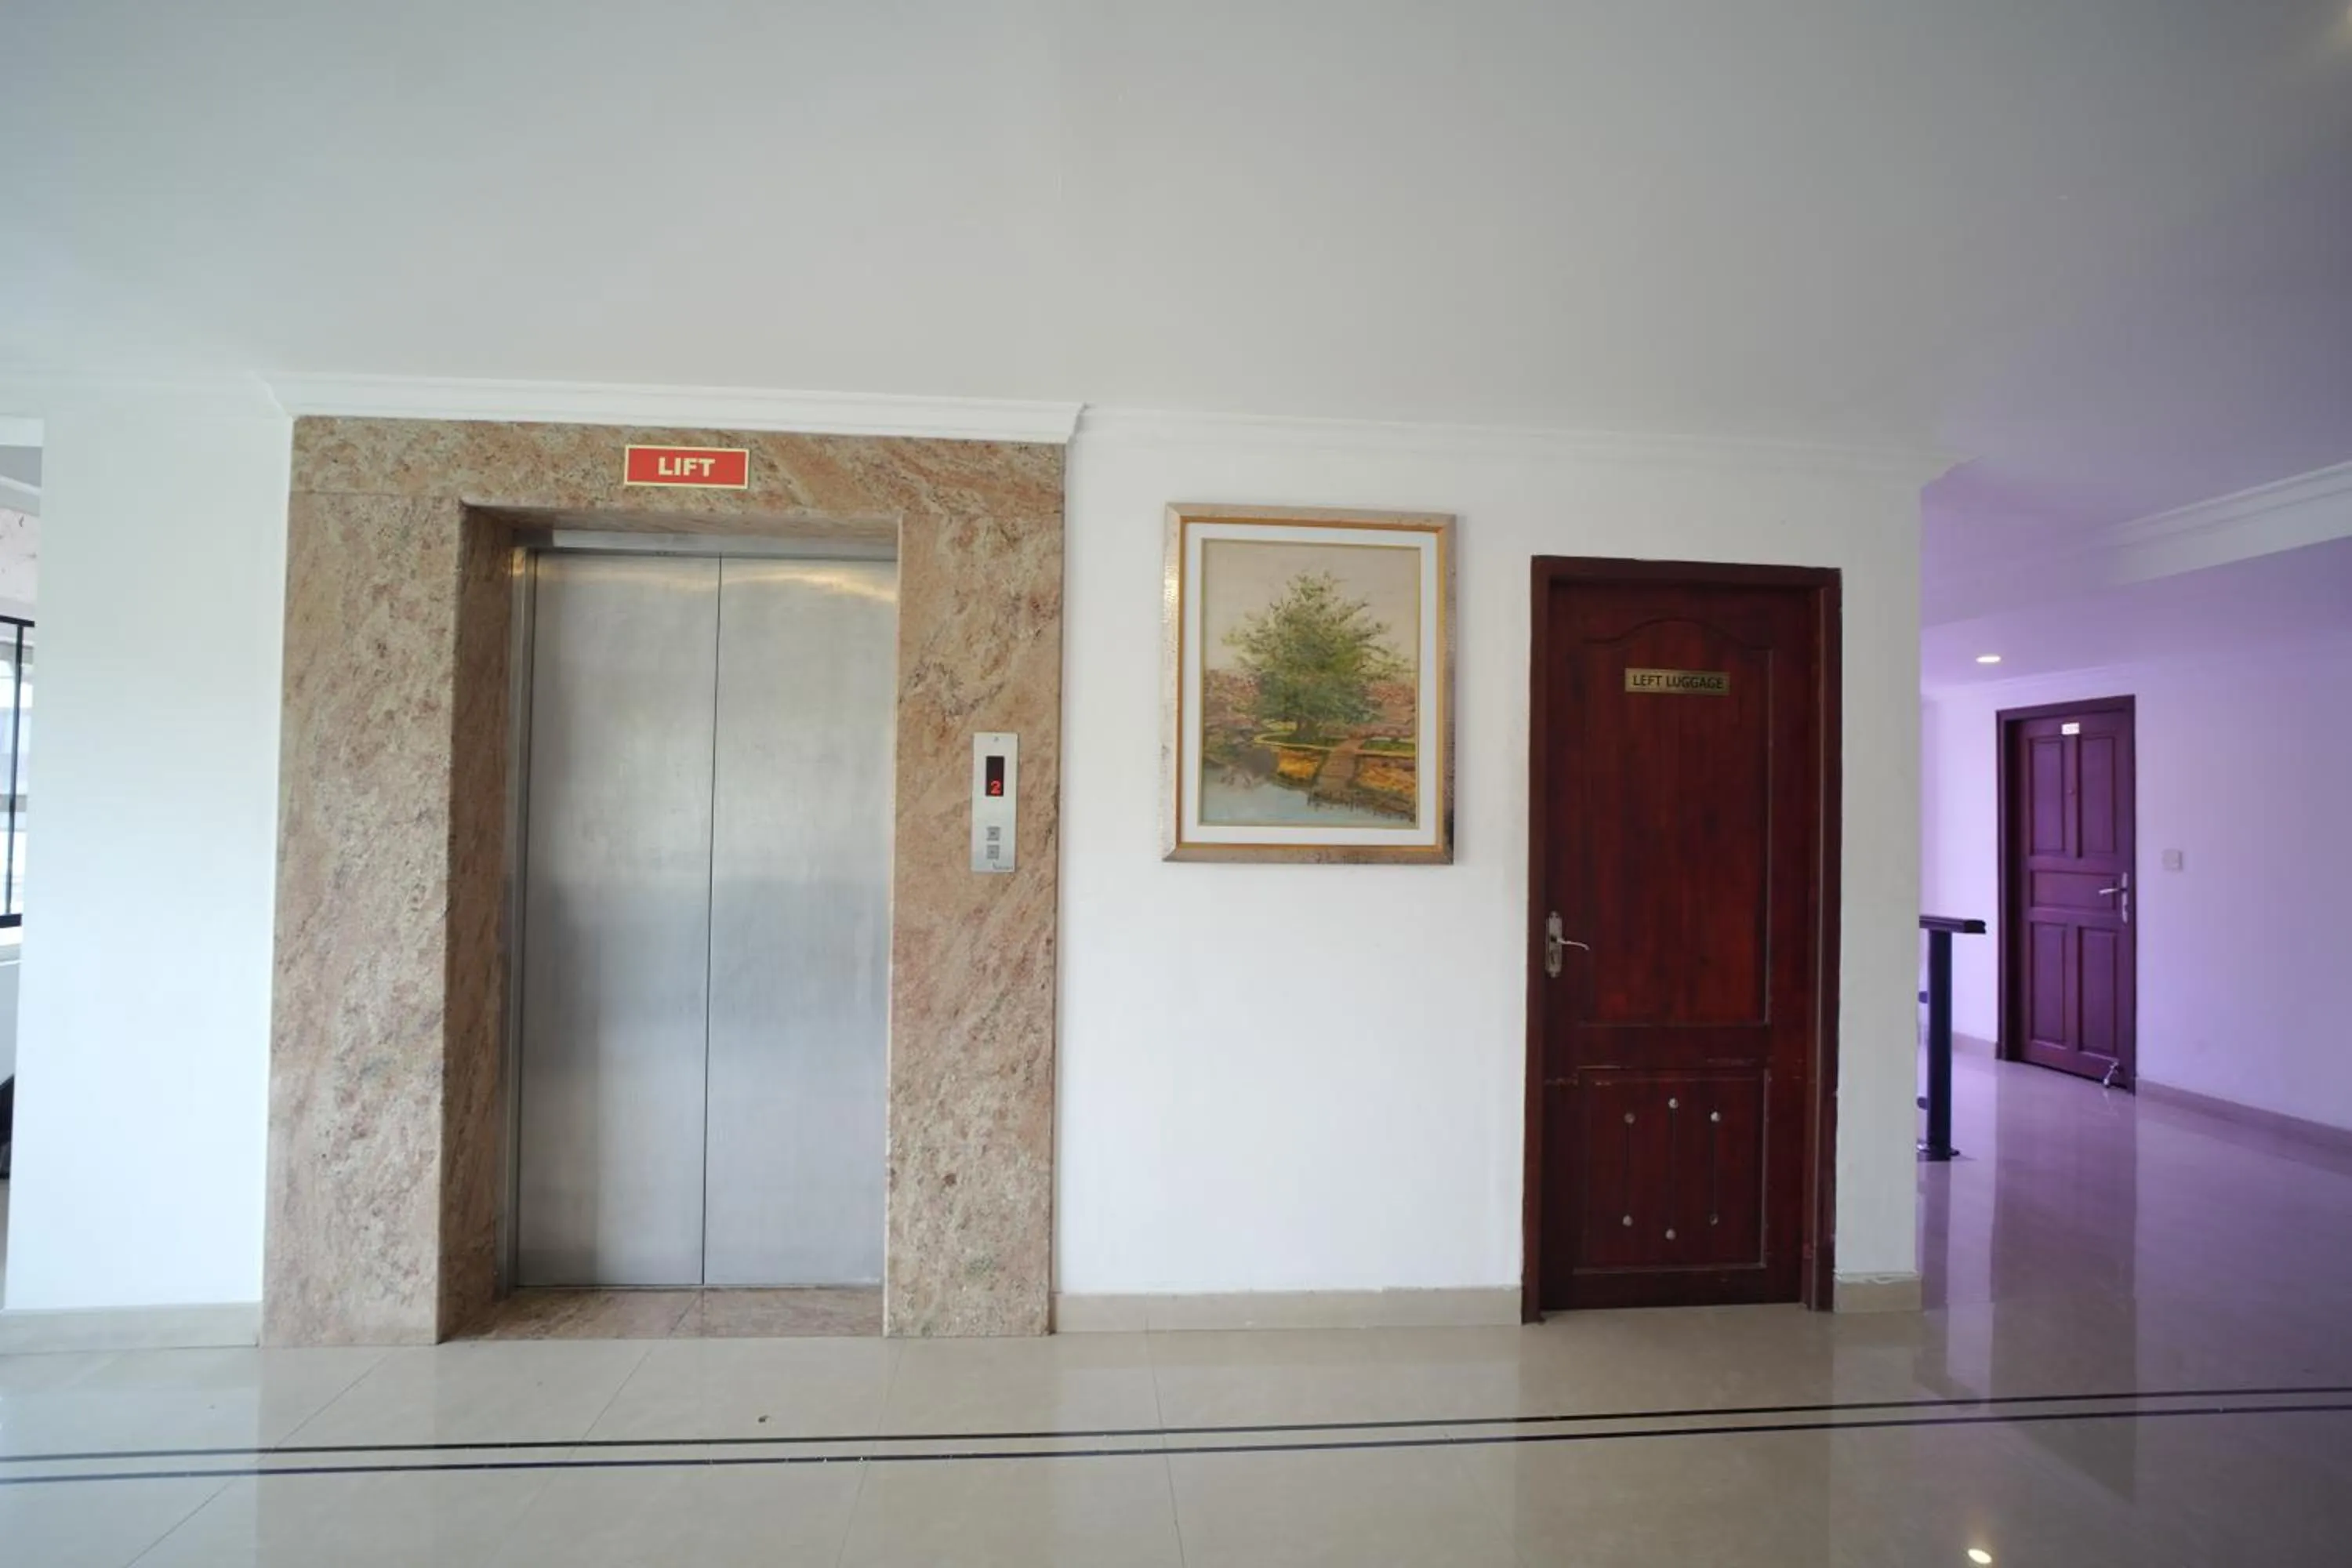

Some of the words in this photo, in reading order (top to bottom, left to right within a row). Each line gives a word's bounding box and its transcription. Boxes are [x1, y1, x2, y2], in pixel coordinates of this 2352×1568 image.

[659, 456, 716, 477] LIFT
[1632, 674, 1662, 686] LEFT
[1666, 675, 1724, 689] LUGGAGE
[990, 780, 1002, 795] 2
